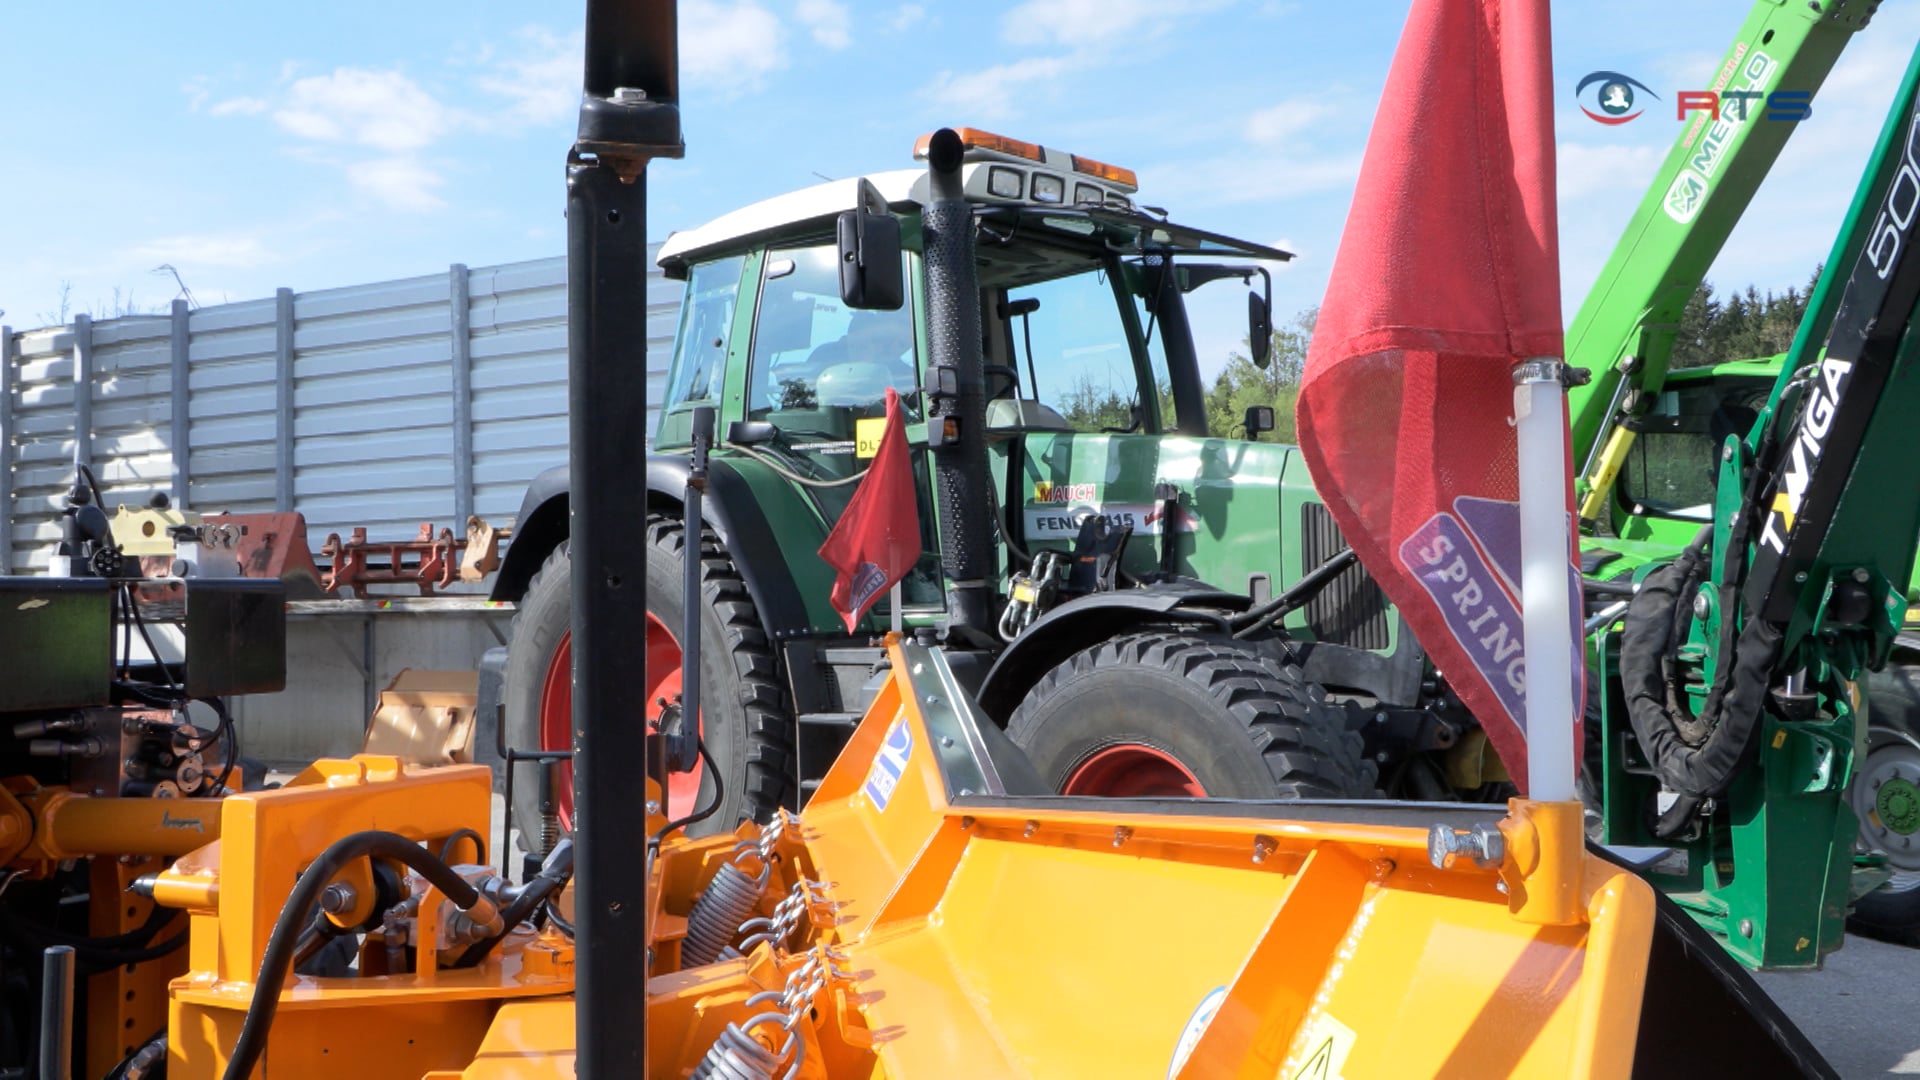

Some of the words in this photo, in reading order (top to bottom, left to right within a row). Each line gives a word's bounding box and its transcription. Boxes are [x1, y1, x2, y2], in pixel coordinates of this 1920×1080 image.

[1693, 53, 1769, 171] MERLO
[1040, 486, 1095, 501] MAUCH
[1760, 357, 1853, 555] TWIGA
[1036, 516, 1082, 530] FEN
[1419, 534, 1527, 698] SPRING
